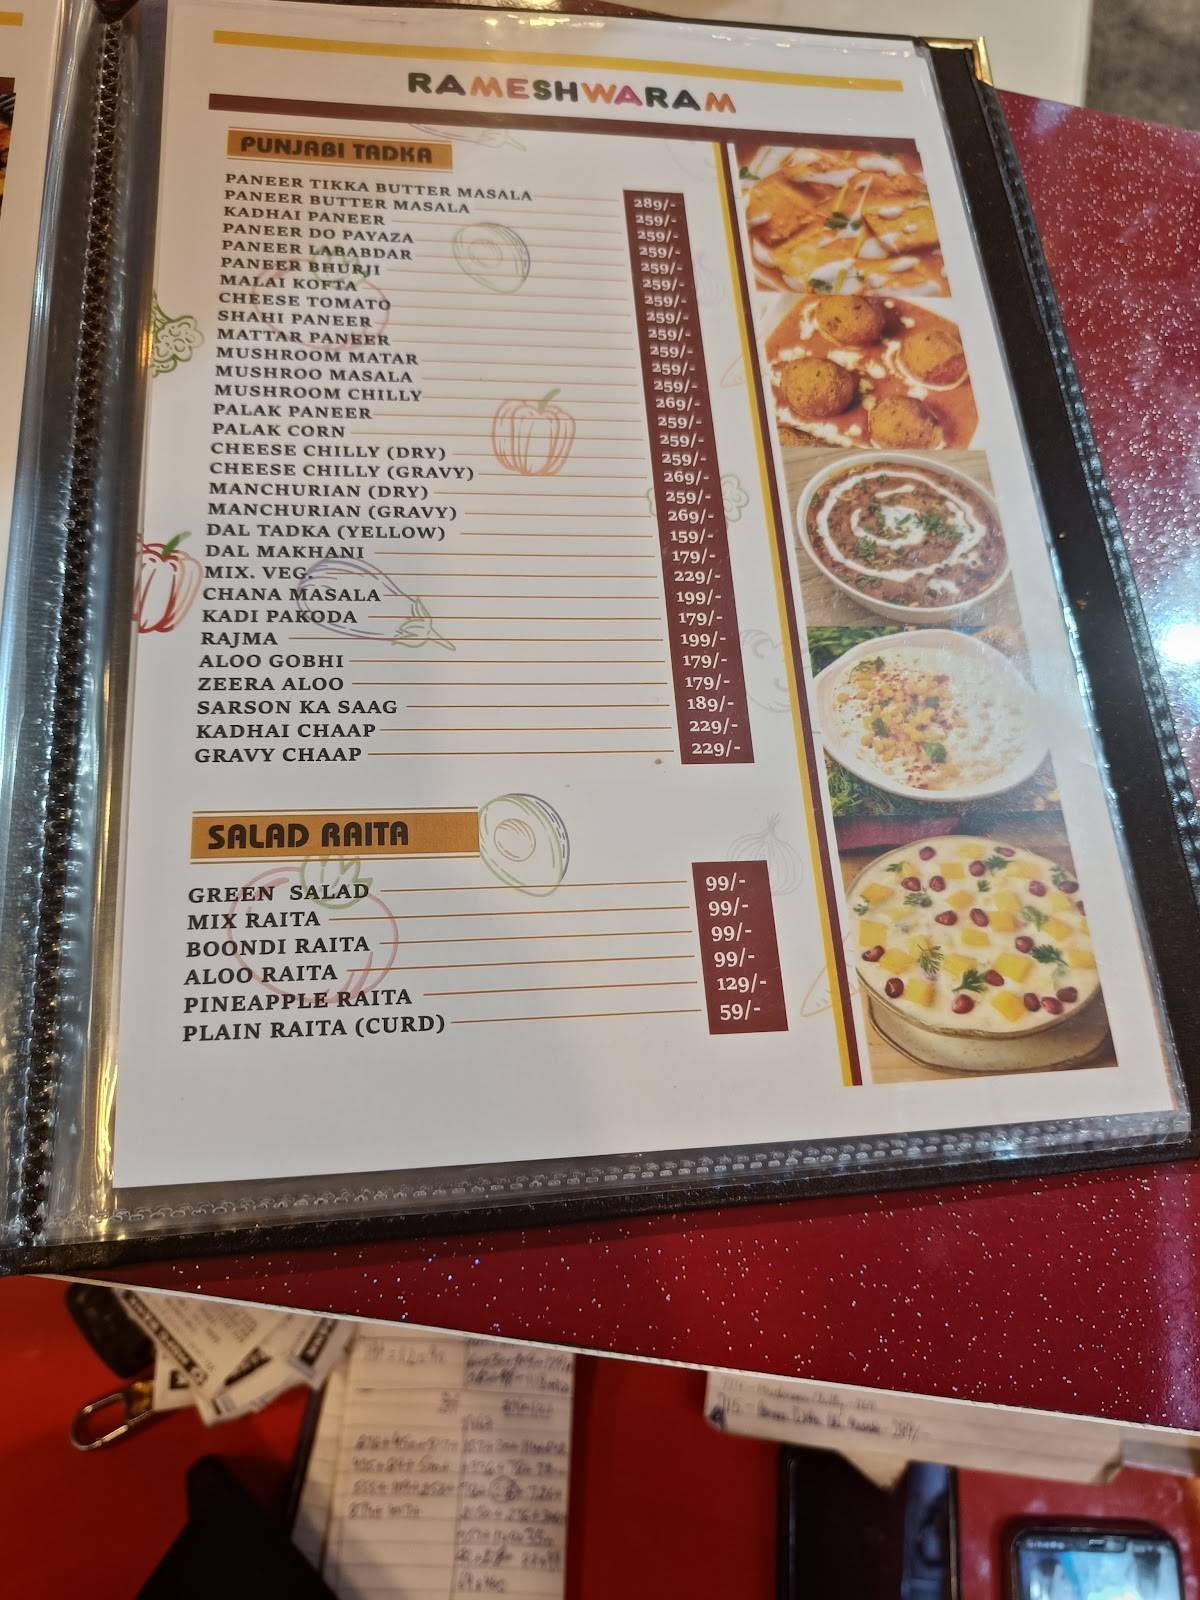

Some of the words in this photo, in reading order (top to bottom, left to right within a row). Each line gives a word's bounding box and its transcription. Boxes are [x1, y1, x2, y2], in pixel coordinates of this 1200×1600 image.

[408, 72, 736, 114] RAMESHWARAM
[240, 135, 344, 159] PUNJABI
[353, 144, 432, 164] TADKA
[225, 173, 304, 188] PANEER
[310, 179, 369, 192] TIKKA
[376, 183, 450, 197] BUTTER
[458, 188, 532, 200] MASALA
[225, 190, 302, 204] PANEER
[310, 195, 386, 209] BUTTER
[393, 200, 470, 213] MASALA
[634, 199, 676, 211] 289/-
[224, 207, 300, 220] KADHAI
[309, 212, 385, 225] PANEER
[636, 214, 677, 227] 259/-
[223, 224, 302, 237] PANEER
[309, 228, 336, 239] DO
[343, 230, 414, 244] PAYAZA
[637, 230, 679, 242] 259/-
[222, 240, 301, 254] PANEER
[309, 245, 412, 260] LABABDAR
[639, 246, 680, 258] 259/-
[221, 257, 300, 272] PANEER
[309, 262, 380, 277] BHURJI
[641, 262, 683, 275] 259/-
[220, 275, 285, 288] MALAI
[293, 279, 357, 291] KOFTA
[643, 278, 685, 291] 259/-
[219, 292, 300, 306] CHEESE
[307, 297, 391, 310] TOMATO
[645, 295, 687, 307] 259/-
[218, 310, 284, 324] SHAHI
[292, 314, 372, 327] PANEER
[647, 311, 689, 324] 259/-
[217, 329, 301, 342] MATTAR
[310, 333, 390, 345] PANEER
[648, 328, 691, 341] 259/-
[216, 347, 341, 362] MUSHROOM
[349, 352, 418, 365] MATAR
[650, 345, 693, 358] 259/-
[215, 366, 322, 380] MUSHROO
[330, 369, 413, 383] MASALA
[652, 363, 695, 376] 259/-
[214, 385, 341, 399] MUSHROOM
[348, 389, 422, 402] CHILLY
[654, 379, 698, 393] 259/-
[214, 404, 281, 417] PALAK
[289, 406, 373, 419] PANEER
[656, 397, 700, 411] 269/-
[658, 415, 702, 429] 259/-
[212, 423, 281, 436] PALAK
[288, 425, 346, 438] CORN
[660, 434, 704, 448] 259/-
[211, 443, 296, 456] CHEESE
[304, 445, 380, 458] CHILLY
[387, 447, 445, 460] (DRY)
[662, 452, 706, 466] 259/-
[210, 462, 296, 476] CHEESE
[303, 465, 381, 477] CHILLY
[387, 466, 473, 480] (GRAVY)
[664, 471, 709, 485] 269/-
[209, 483, 360, 497] MANCHURIAN
[369, 485, 428, 500] (DRY)
[666, 490, 711, 504] 259/-
[208, 503, 360, 518] MANCHURIAN
[368, 505, 457, 521] (GRAVY)
[668, 510, 714, 524] 269/-
[206, 523, 249, 536] DAL
[257, 525, 331, 537] TADKA
[337, 526, 445, 541] (YELLOW)
[670, 530, 713, 544] 159/-
[205, 545, 249, 557] DAL
[257, 545, 364, 559] MAKHANI
[672, 549, 715, 564] 179/-
[204, 566, 255, 579] MIX.
[262, 567, 313, 579] VEG.
[674, 569, 720, 584] 229/-
[203, 588, 282, 600] CHANA
[289, 588, 381, 601] MASALA
[676, 589, 721, 605] 199/-
[202, 610, 258, 623] KADI
[266, 610, 357, 623] PAKODA
[679, 610, 723, 626] 179/-
[201, 632, 278, 648] RAJMA
[681, 631, 726, 647] 199/-
[198, 655, 261, 668] ALOO
[269, 655, 344, 668] GOBHI
[683, 652, 727, 669] 179/-
[198, 677, 275, 691] ZEERA
[282, 678, 344, 691] ALOO
[685, 674, 730, 690] 179/-
[197, 701, 291, 714] SARSON
[300, 700, 331, 714] KA
[337, 700, 397, 714] SAAG
[687, 696, 734, 712] 189/-
[196, 724, 289, 738] KADHAI
[297, 724, 376, 737] CHAAP
[689, 718, 738, 734] 229/-
[195, 749, 275, 763] GRAVY
[283, 748, 362, 761] CHAAP
[692, 740, 741, 757] 229/-
[208, 824, 309, 849] SALAD
[322, 821, 409, 847] RAITA
[706, 872, 745, 891] 99/-
[188, 886, 274, 903] GREEN
[290, 883, 369, 900] SALAD
[708, 897, 748, 916] 99/-
[188, 913, 237, 929] MIX
[246, 911, 320, 928] RAITA
[711, 922, 751, 941] 99/-
[186, 939, 286, 958] BOONDI
[295, 937, 370, 954] RAITA
[714, 948, 755, 967] 99/-
[184, 967, 253, 985] ALOO
[262, 965, 338, 982] RAITA
[717, 973, 767, 993] 129/-
[183, 992, 328, 1013] PINEAPPLE
[337, 989, 412, 1007] RAITA
[720, 1000, 760, 1020] 59/-
[182, 1022, 261, 1042] PLAIN
[270, 1019, 347, 1038] RAITA
[355, 1015, 445, 1037] (CURD)
